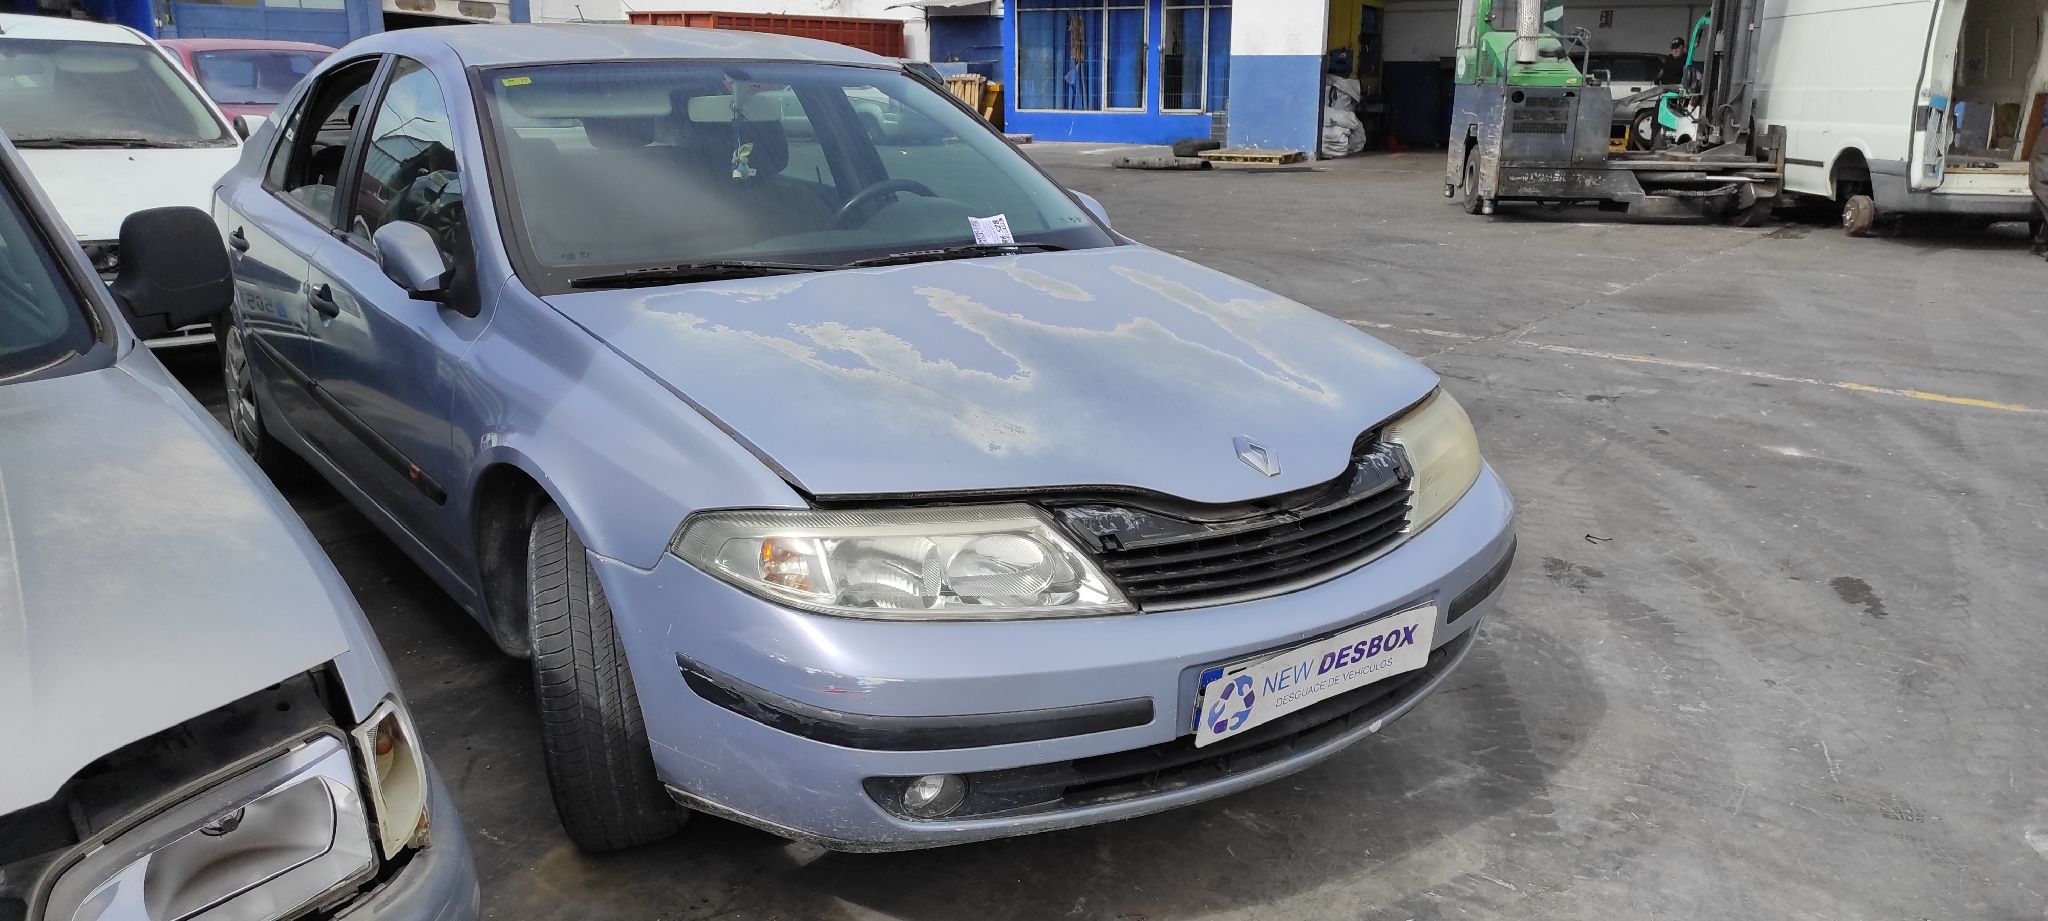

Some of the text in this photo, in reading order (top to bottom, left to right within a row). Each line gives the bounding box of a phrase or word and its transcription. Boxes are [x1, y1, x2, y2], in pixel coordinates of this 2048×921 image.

[1262, 623, 1419, 696] NEW DESBOX
[1275, 680, 1327, 708] DESGUACE
[1327, 674, 1341, 688] DE
